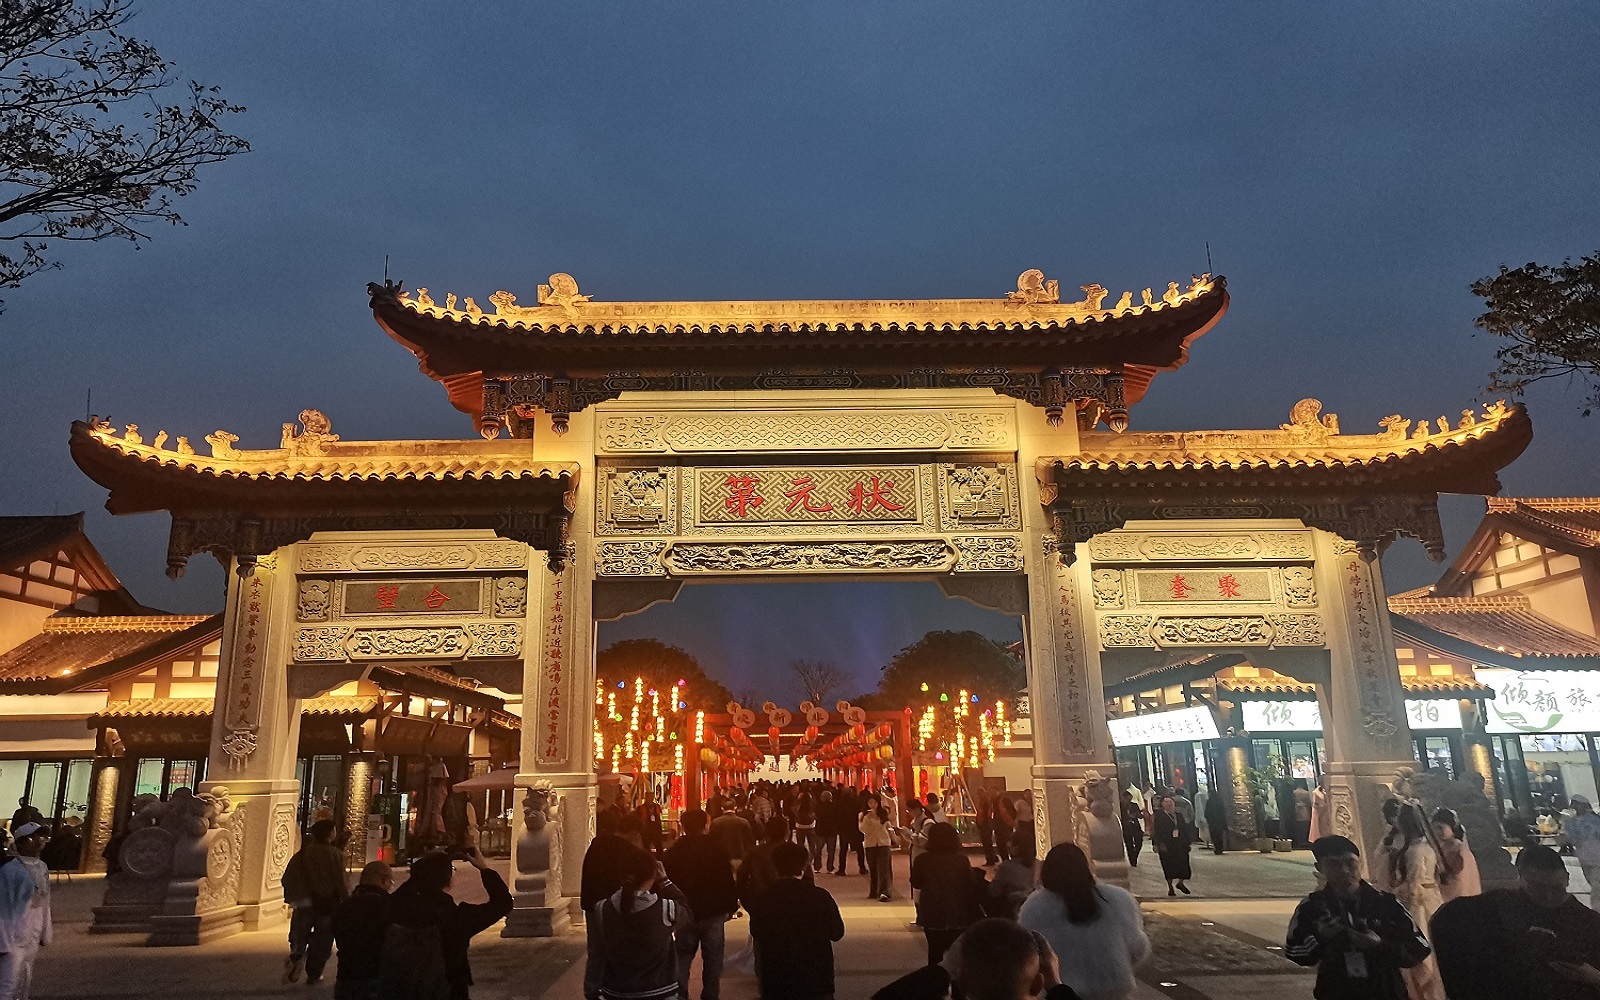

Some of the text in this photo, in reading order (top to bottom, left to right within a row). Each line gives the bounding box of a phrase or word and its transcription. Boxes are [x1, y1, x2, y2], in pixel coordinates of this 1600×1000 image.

[1500, 681, 1600, 712] 倾颜旅
[1409, 700, 1440, 723] 拍
